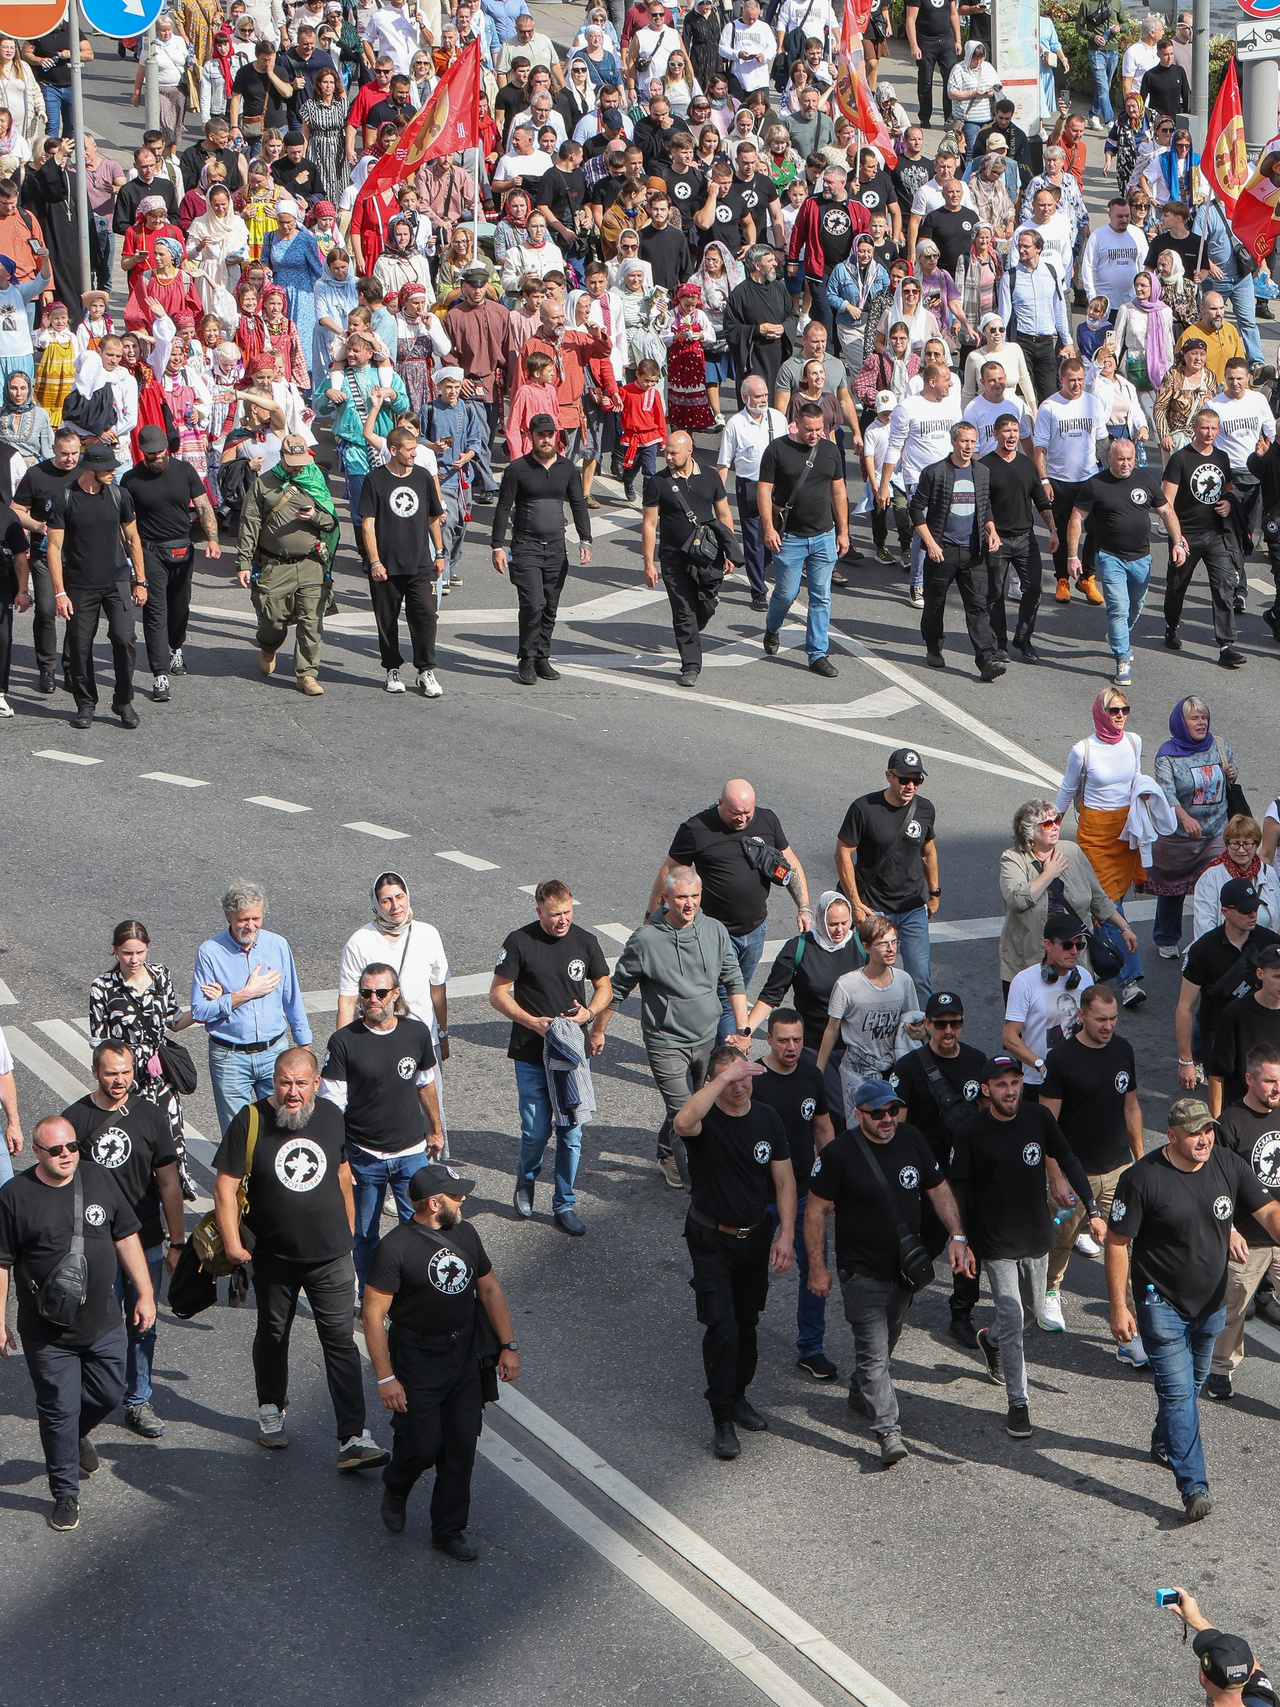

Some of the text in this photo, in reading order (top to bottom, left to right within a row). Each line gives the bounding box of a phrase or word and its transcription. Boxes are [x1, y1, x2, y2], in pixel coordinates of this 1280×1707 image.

[277, 1138, 325, 1168] РУССКАЯ ОБЩИНА
[1254, 1132, 1273, 1163] РУССКАЯ
[281, 1172, 322, 1190] МОРДОВИЯ
[435, 1276, 470, 1293] ОБЩИНА
